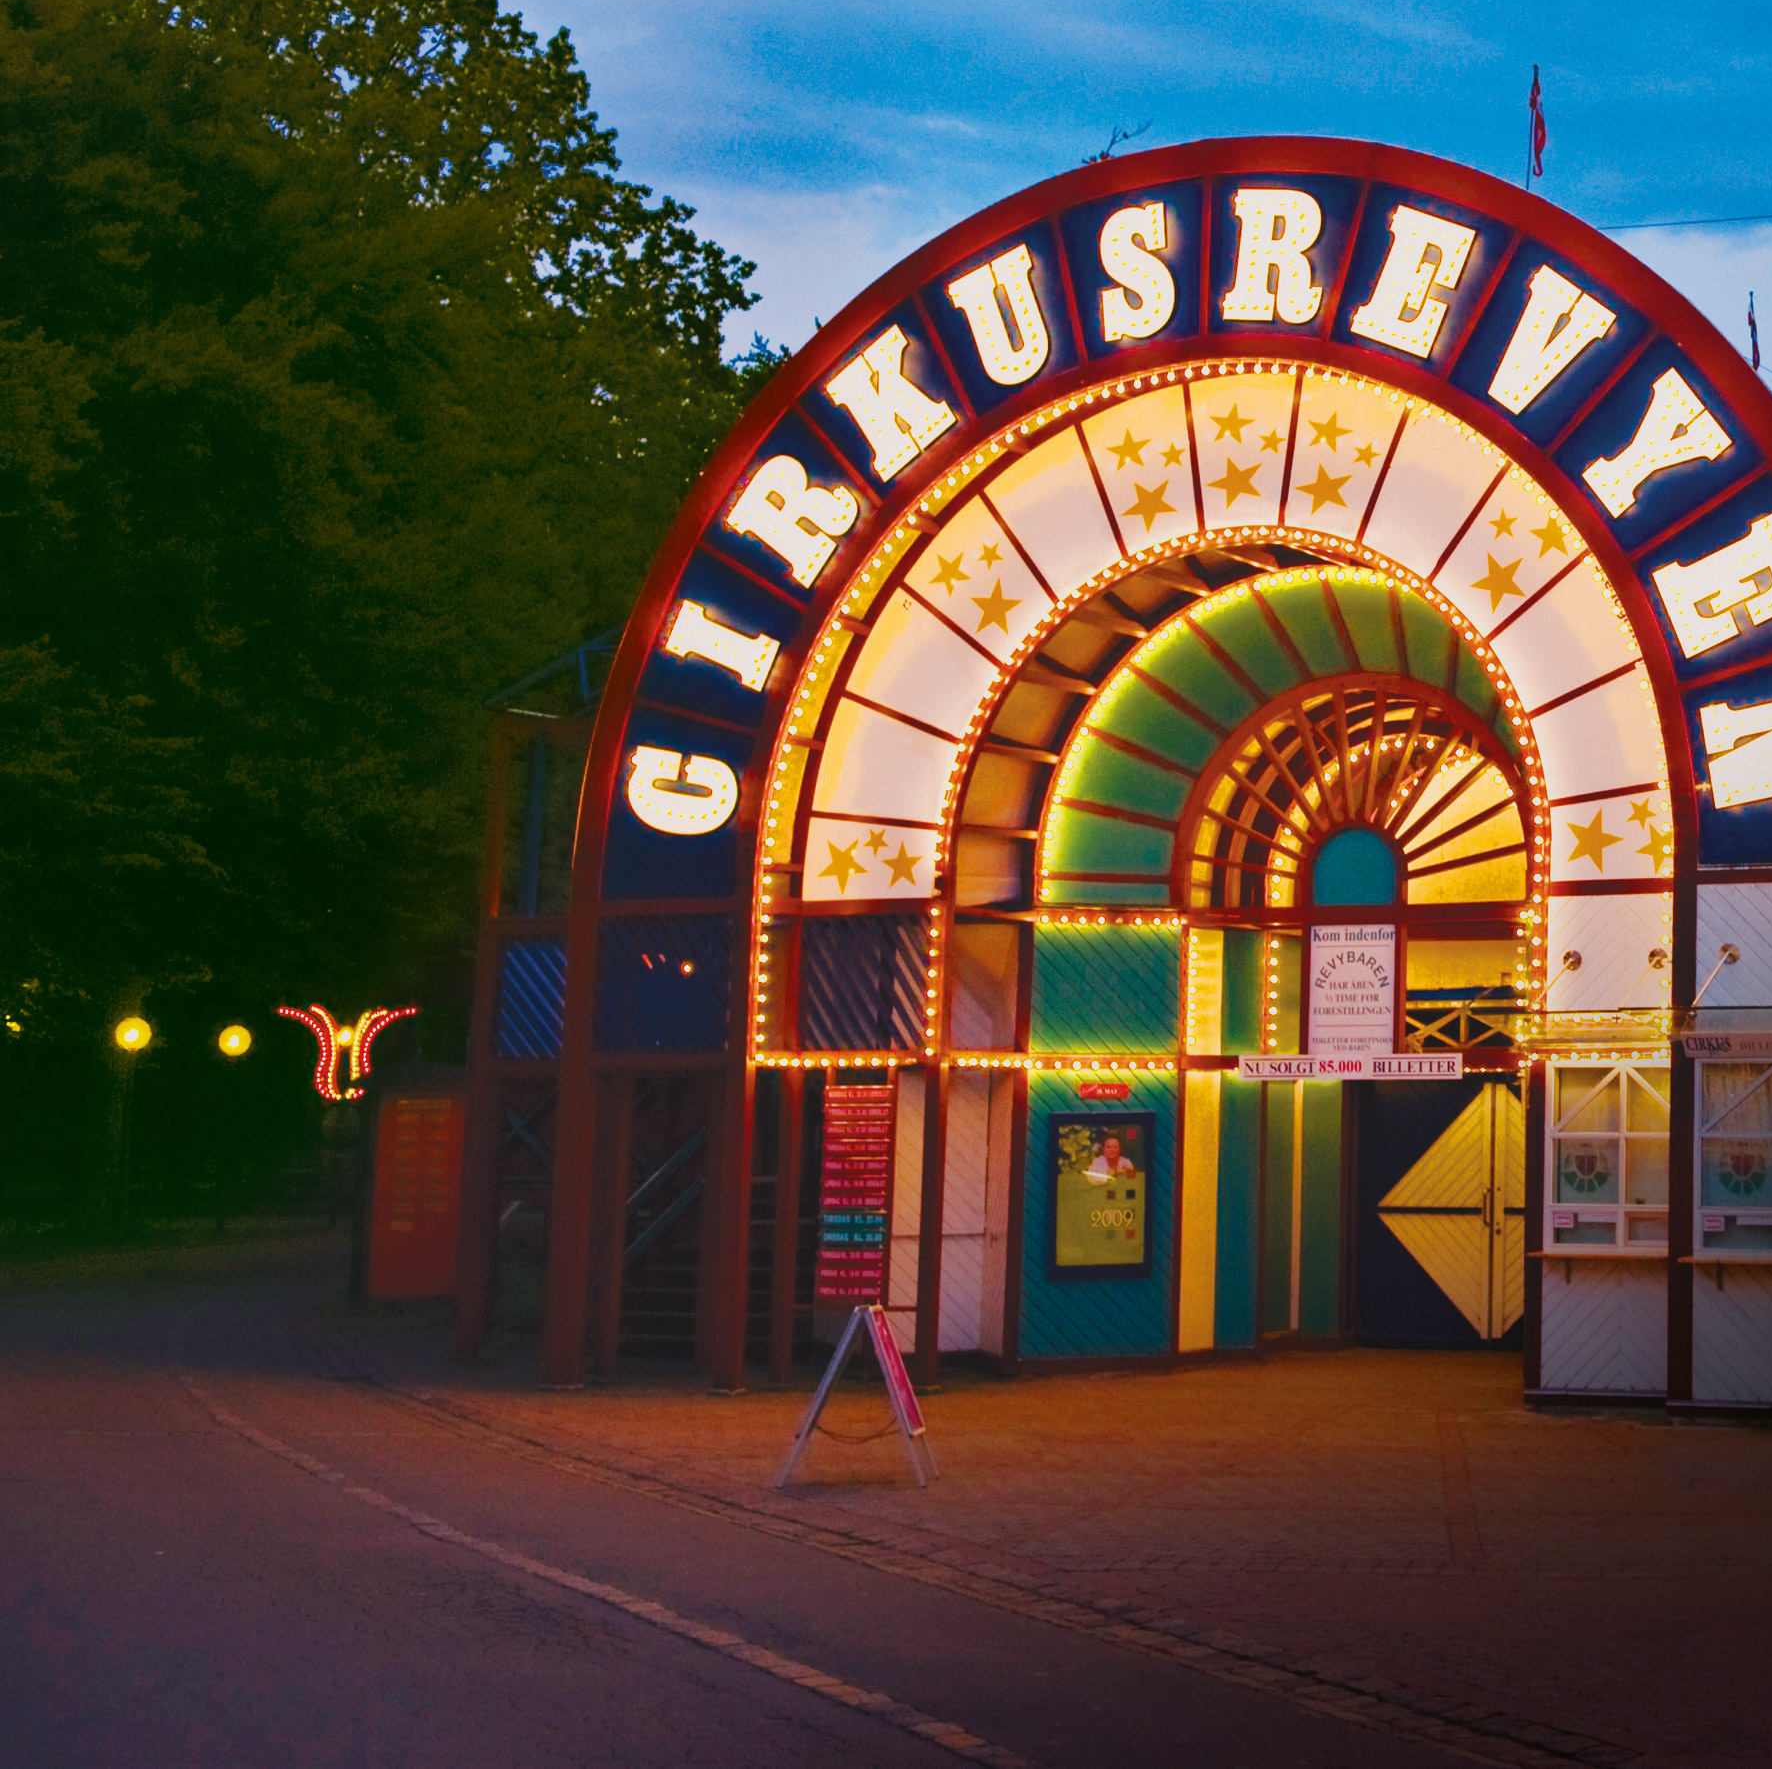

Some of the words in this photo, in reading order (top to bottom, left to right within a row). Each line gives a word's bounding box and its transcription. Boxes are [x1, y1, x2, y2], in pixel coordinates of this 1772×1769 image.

[1313, 928, 1340, 942] Kom
[1345, 927, 1394, 941] indenfor
[1315, 951, 1390, 989] REVYBAREN
[1329, 981, 1348, 990] HAR
[1335, 994, 1357, 1003] TIME
[1313, 1006, 1391, 1015] FORESTILLINGEN
[1685, 1036, 1732, 1053] CIRKUS
[1244, 1062, 1265, 1074] NU
[1269, 1061, 1316, 1074] SOLGT
[1318, 1060, 1362, 1074] 85.000
[1372, 1061, 1456, 1074] BILLETTER
[1091, 1209, 1134, 1228] 2009
